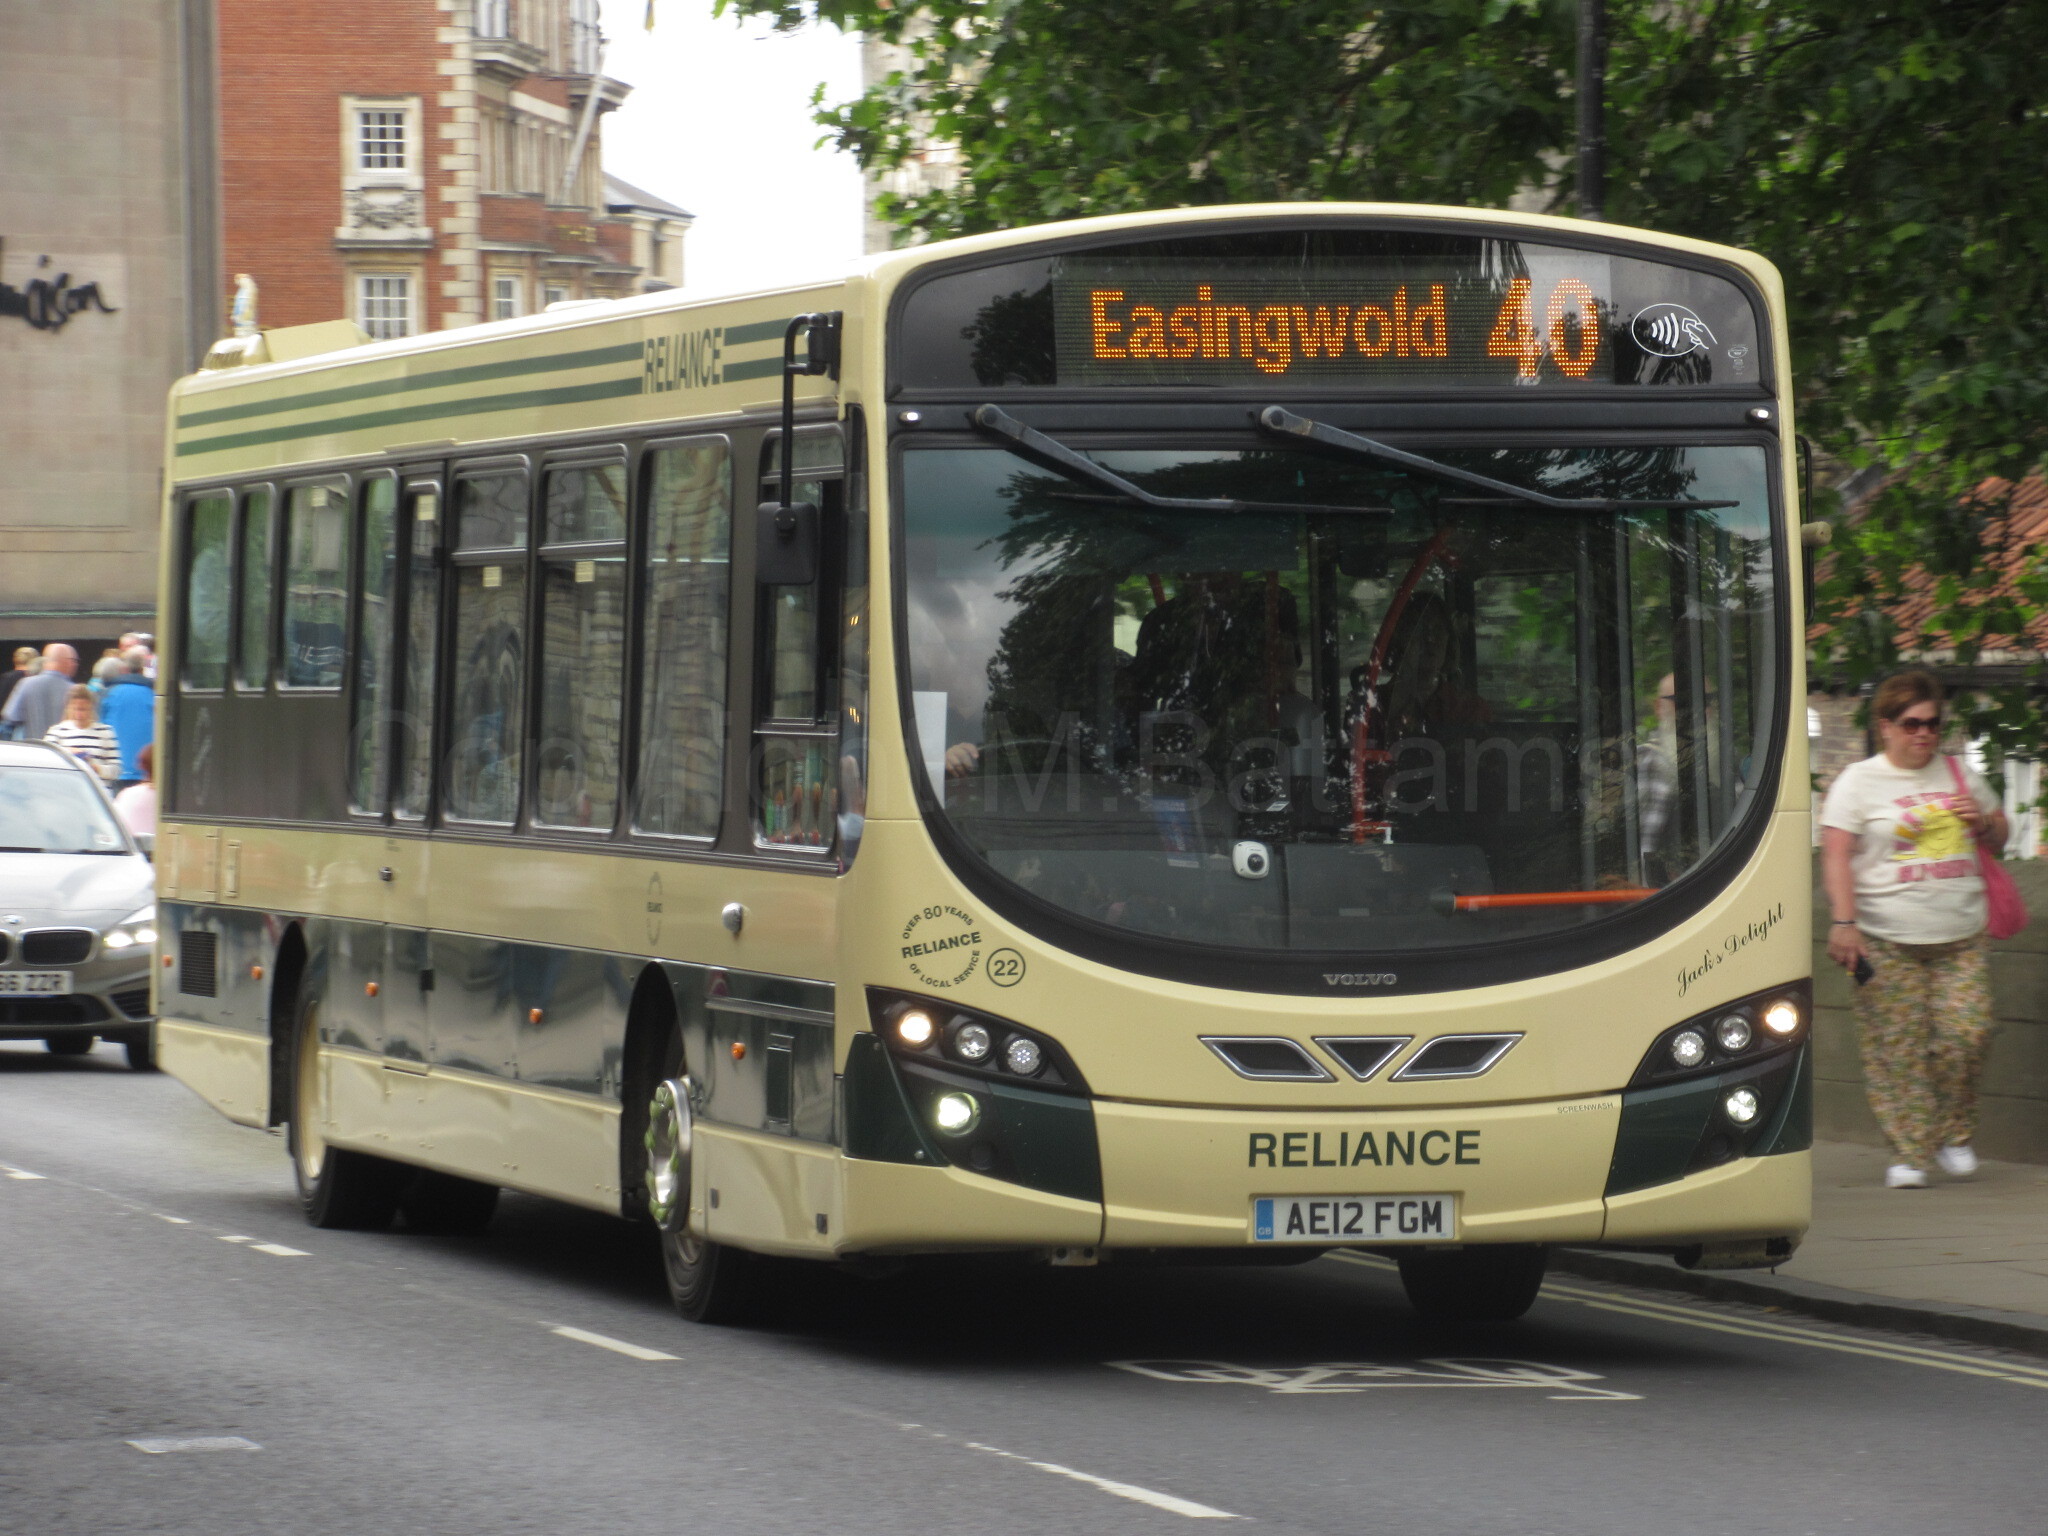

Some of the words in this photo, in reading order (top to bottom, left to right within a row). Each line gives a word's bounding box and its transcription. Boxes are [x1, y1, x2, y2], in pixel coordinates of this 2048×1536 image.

[1091, 284, 1448, 374] Easingwold
[1486, 279, 1599, 378] 40
[642, 327, 722, 394] RELIANCE
[902, 914, 922, 940] OVER
[923, 905, 942, 920] 80
[944, 905, 974, 926] YEARS
[902, 931, 982, 958] RELIANCE
[1677, 949, 1723, 998] Jack's
[1724, 902, 1785, 956] Delight
[909, 963, 922, 975] OF
[920, 974, 952, 989] LOCAL
[953, 949, 980, 985] SERVICE
[994, 959, 1019, 977] 22
[1322, 973, 1398, 986] VOLVO
[1557, 1101, 1614, 1114] SCREENWASH
[1248, 1129, 1481, 1168] RELIANCE
[1258, 1226, 1272, 1236] GB
[1286, 1201, 1364, 1236] AE12
[1374, 1200, 1443, 1235] FGM
